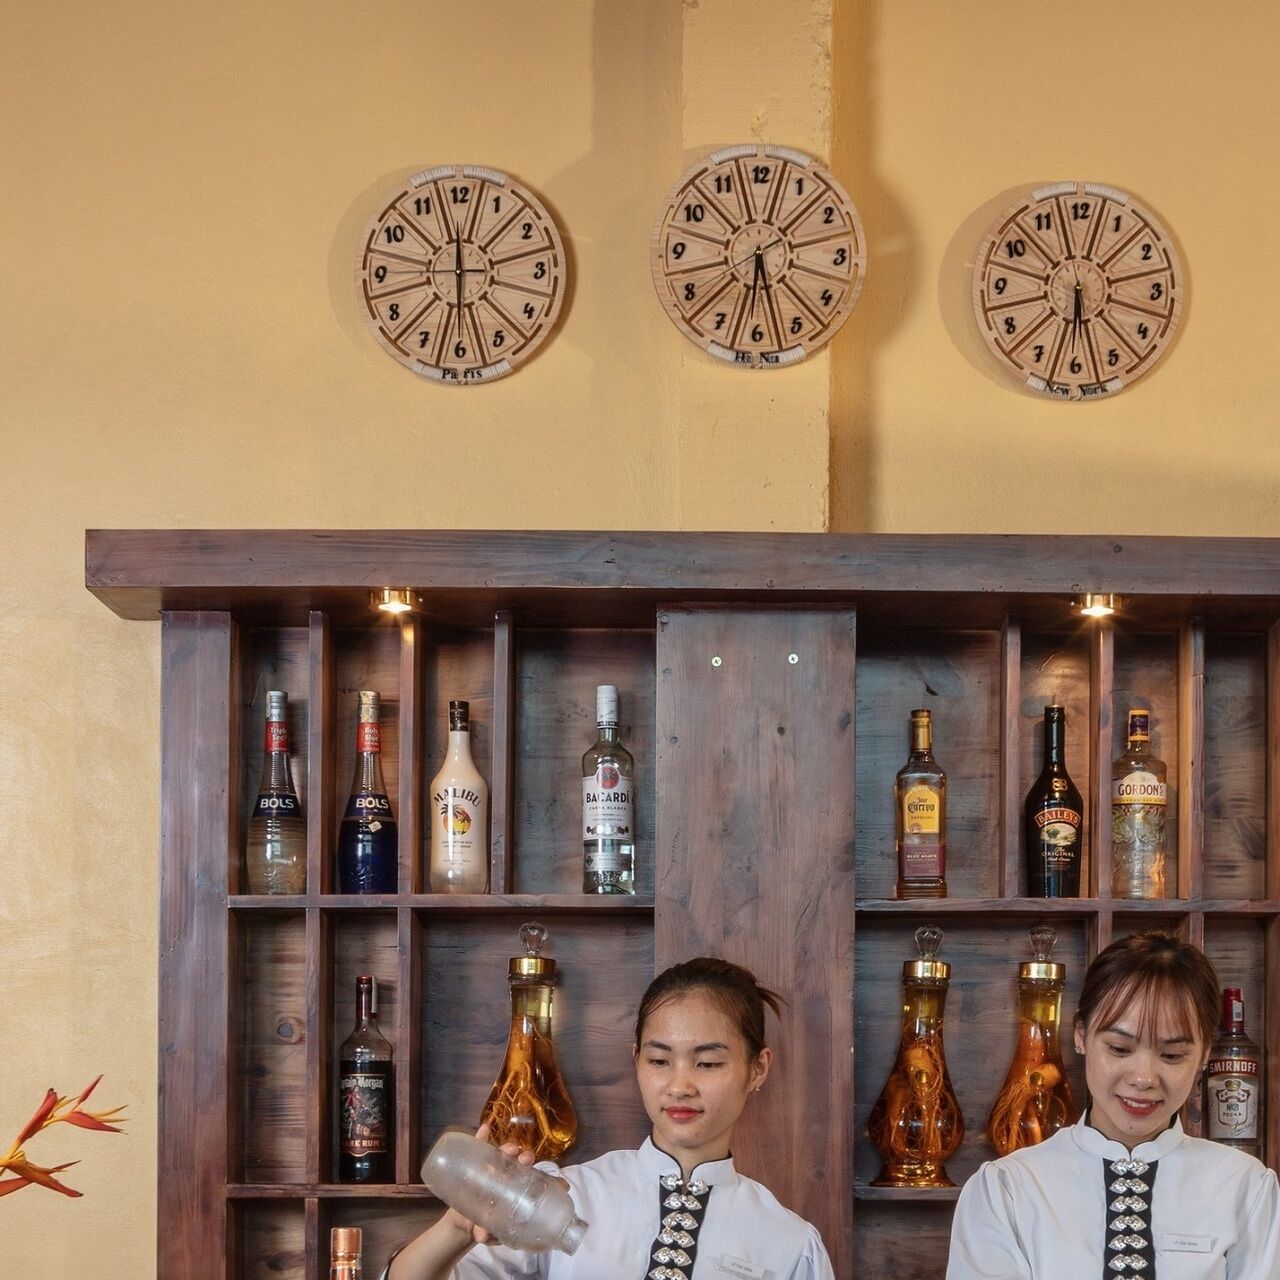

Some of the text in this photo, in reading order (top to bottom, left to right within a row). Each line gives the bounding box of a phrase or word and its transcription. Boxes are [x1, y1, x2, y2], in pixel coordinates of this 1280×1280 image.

[753, 166, 770, 184] 12
[714, 176, 732, 194] 11
[796, 178, 804, 196] 1
[450, 186, 469, 203] 12
[414, 197, 431, 215] 11
[493, 196, 501, 213] 1
[684, 204, 704, 222] 10
[1072, 202, 1090, 220] 12
[823, 206, 834, 224] 2
[1034, 212, 1052, 230] 11
[1114, 215, 1122, 232] 1
[384, 225, 404, 243] 10
[521, 223, 532, 239] 2
[672, 242, 686, 260] 9
[833, 248, 846, 266] 3
[1005, 240, 1025, 258] 10
[1142, 244, 1152, 260] 2
[375, 266, 387, 283] 9
[533, 262, 546, 279] 3
[684, 283, 695, 300] 8
[994, 278, 1007, 294] 9
[1150, 282, 1163, 300] 3
[821, 289, 833, 306] 4
[389, 303, 400, 321] 8
[523, 303, 535, 319] 4
[714, 313, 726, 330] 7
[790, 316, 802, 334] 5
[1004, 317, 1016, 334] 8
[493, 330, 505, 347] 5
[751, 324, 764, 342] 6
[1137, 322, 1149, 339] 4
[419, 332, 430, 348] 7
[454, 340, 467, 358] 6
[1033, 346, 1044, 362] 7
[1108, 349, 1119, 366] 5
[1069, 356, 1082, 374] 6
[441, 369, 482, 379] Paris
[1043, 381, 1108, 395] New York
[260, 798, 294, 808] BOLS
[355, 797, 389, 808] BOLS
[433, 788, 481, 807] MALIBU
[1038, 810, 1079, 823] BAILEYS
[1209, 1060, 1257, 1073] SMIRNOFF
